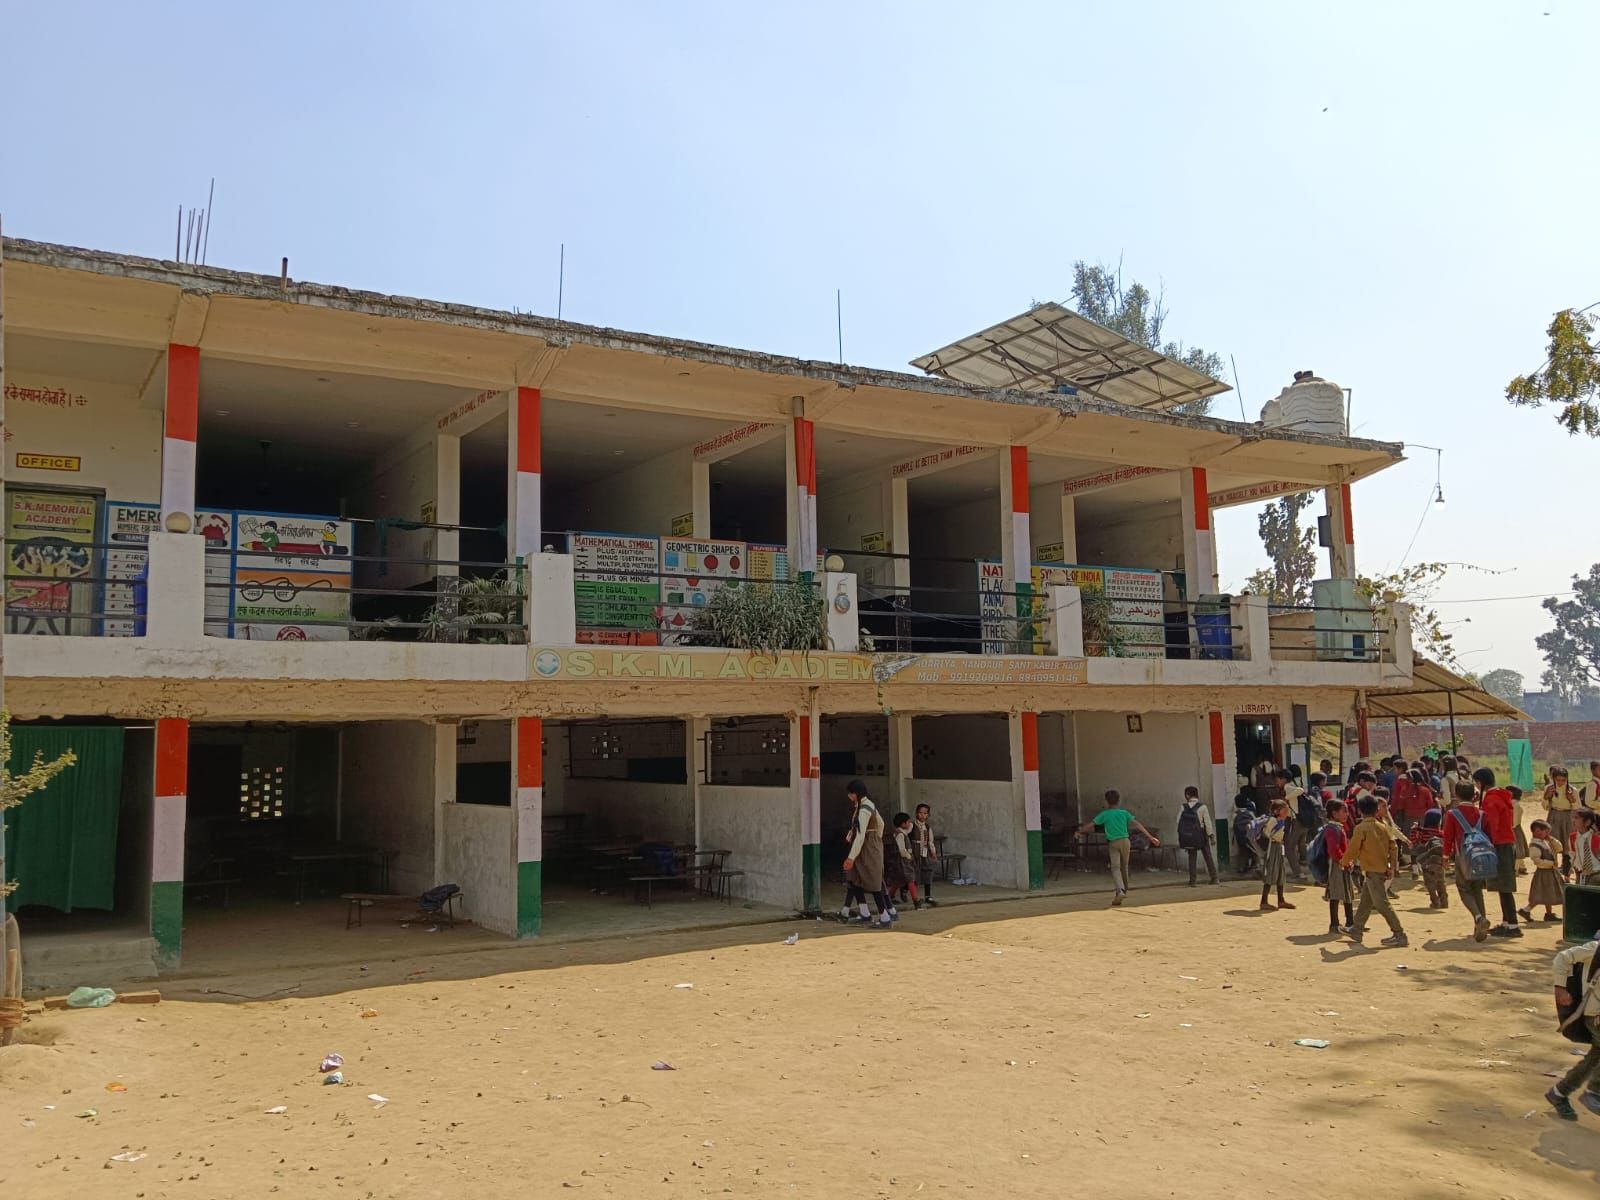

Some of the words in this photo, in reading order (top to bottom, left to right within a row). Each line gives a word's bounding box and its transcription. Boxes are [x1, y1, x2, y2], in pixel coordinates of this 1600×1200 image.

[21, 457, 73, 469] OFFICE
[920, 454, 939, 467] BETTER
[940, 450, 953, 460] THAN
[25, 514, 78, 526] ACADEMY
[125, 534, 146, 542] NAME
[574, 536, 628, 548] MATHEMATICAL
[666, 542, 710, 553] GEOMETRIC
[711, 544, 740, 555] SHAPES
[597, 574, 616, 582] PLUS
[1071, 570, 1079, 582] OF
[1080, 570, 1101, 583] INDIA
[605, 586, 627, 594] EQUAL
[629, 587, 638, 595] TO
[565, 650, 705, 678] S.K.M.
[1008, 660, 1032, 670] SANT
[1241, 704, 1273, 713] LIBRARY
